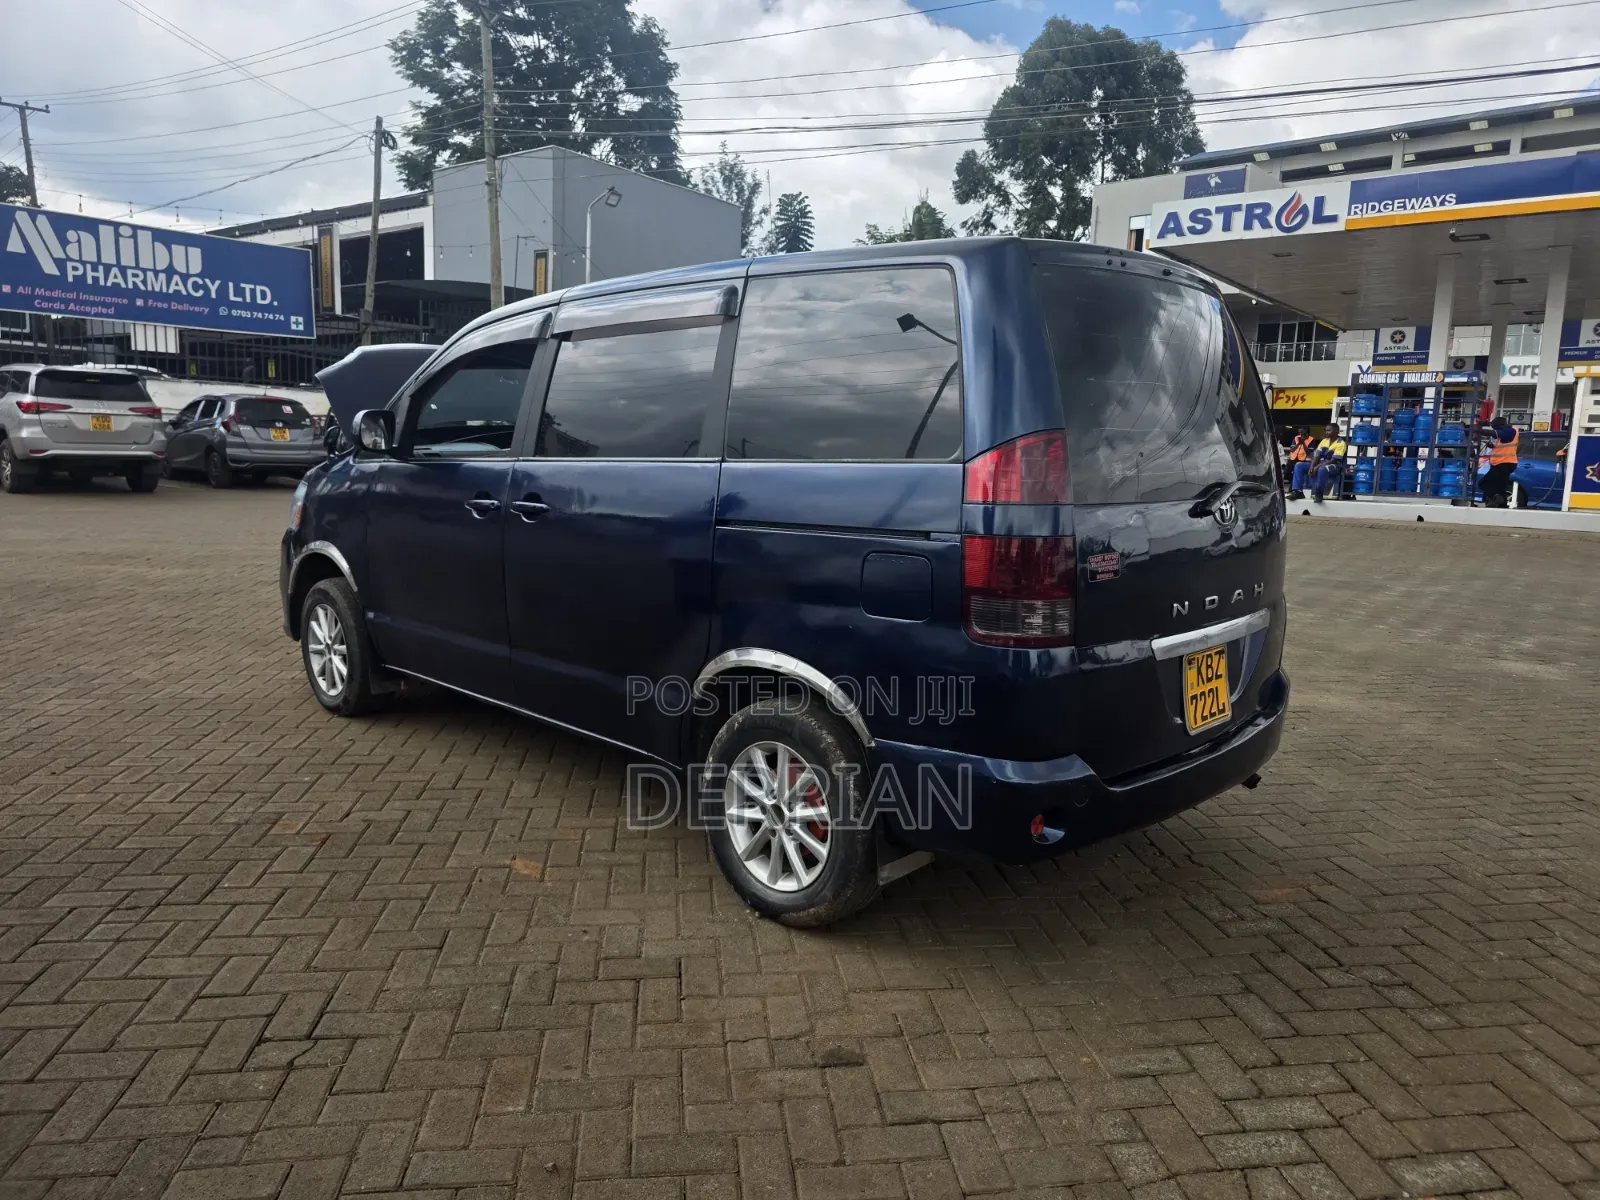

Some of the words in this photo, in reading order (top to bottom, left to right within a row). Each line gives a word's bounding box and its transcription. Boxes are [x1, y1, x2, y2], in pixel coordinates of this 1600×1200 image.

[1156, 191, 1339, 239] ASTROL
[1350, 193, 1457, 217] RIDGEWAYS
[6, 210, 203, 276] Malibu
[17, 285, 32, 295] All
[34, 287, 77, 300] Medical
[79, 292, 129, 305] Insurance
[66, 261, 222, 298] PHARMACY
[228, 282, 279, 306] LTD.
[34, 299, 66, 310] Cards
[68, 302, 115, 315] Accepted
[148, 299, 169, 309] Free
[171, 301, 210, 315] Delivery
[231, 309, 251, 318] 0703
[1358, 373, 1387, 384] COOKING
[1387, 373, 1400, 384] GAS
[1403, 372, 1437, 383] AVAILABLE
[1274, 389, 1307, 408] Frys
[1172, 582, 1264, 618] NOAH
[1196, 649, 1225, 687] KBZ
[1190, 686, 1226, 726] 722L
